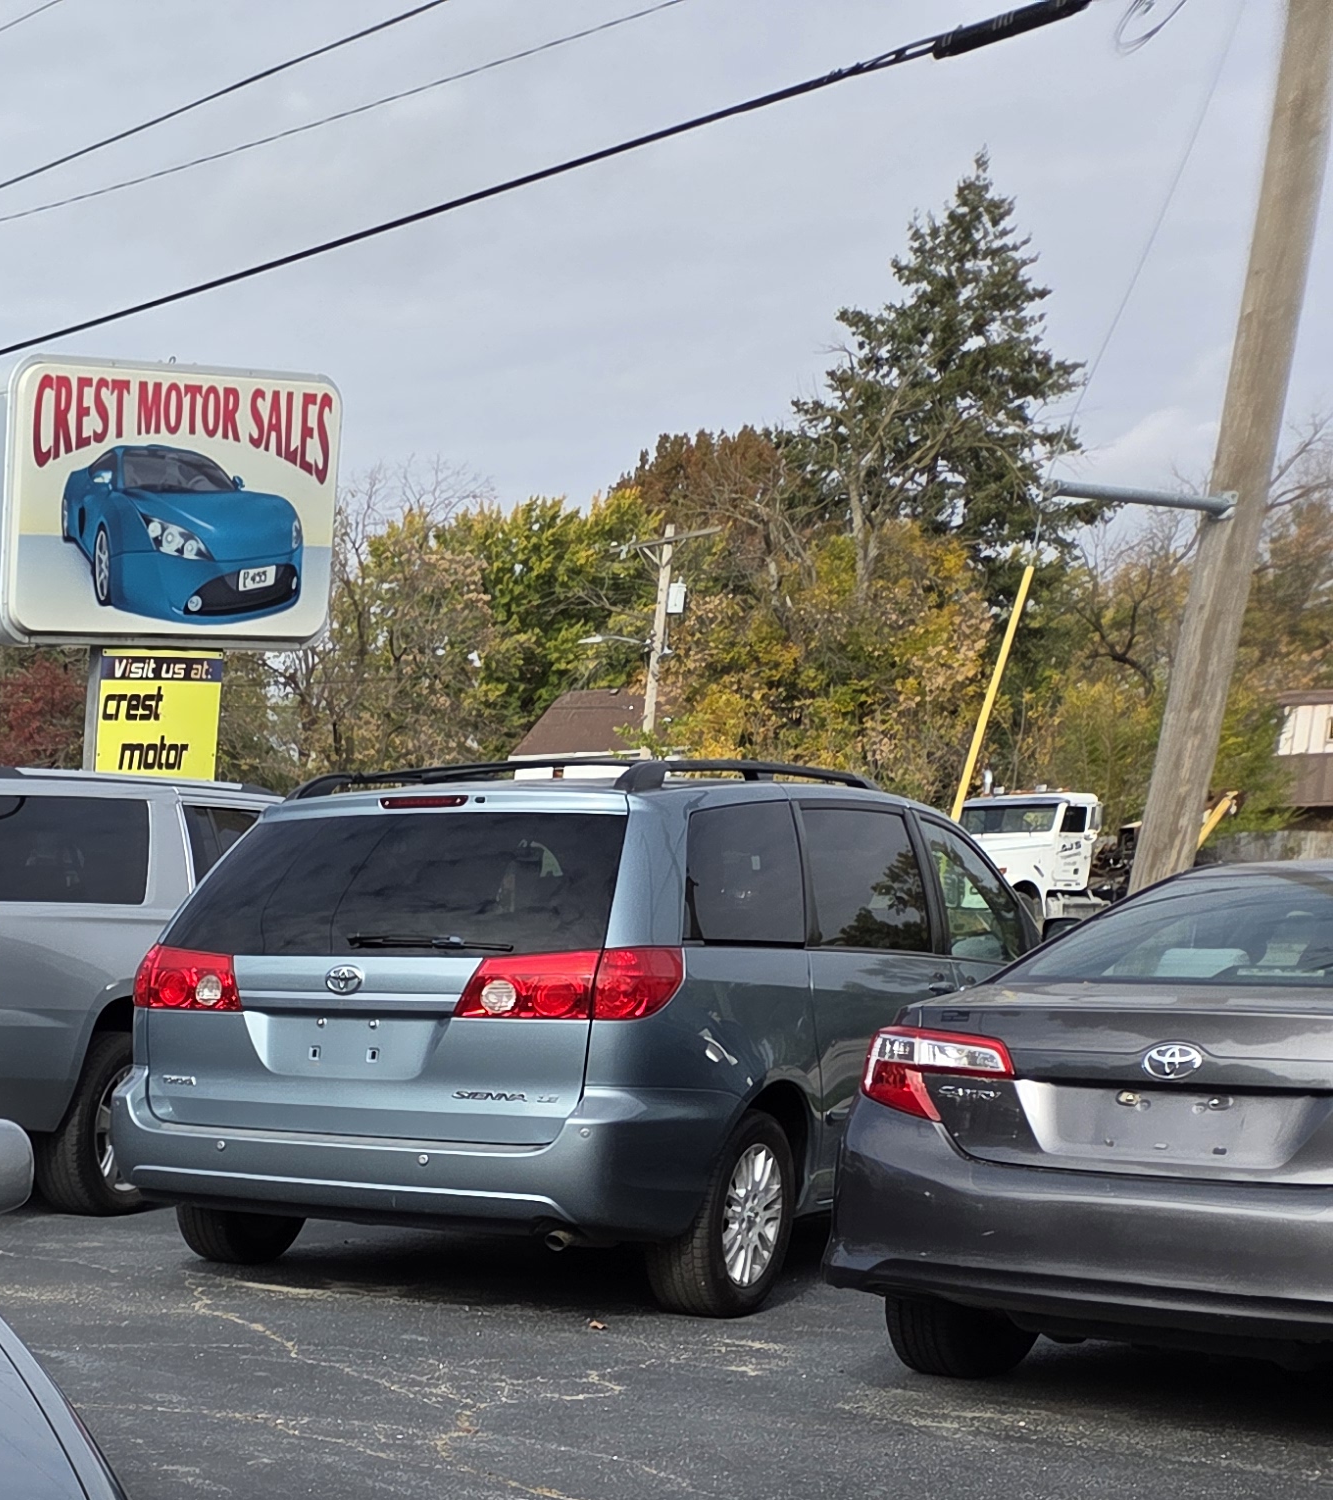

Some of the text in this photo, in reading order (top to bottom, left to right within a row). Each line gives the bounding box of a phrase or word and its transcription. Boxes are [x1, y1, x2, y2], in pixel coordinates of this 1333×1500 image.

[33, 373, 333, 485] CREST MOTOR SALES
[114, 658, 213, 679] Visit us at:
[101, 685, 164, 721] crest
[118, 734, 189, 771] motor
[451, 1090, 528, 1102] SIENNA
